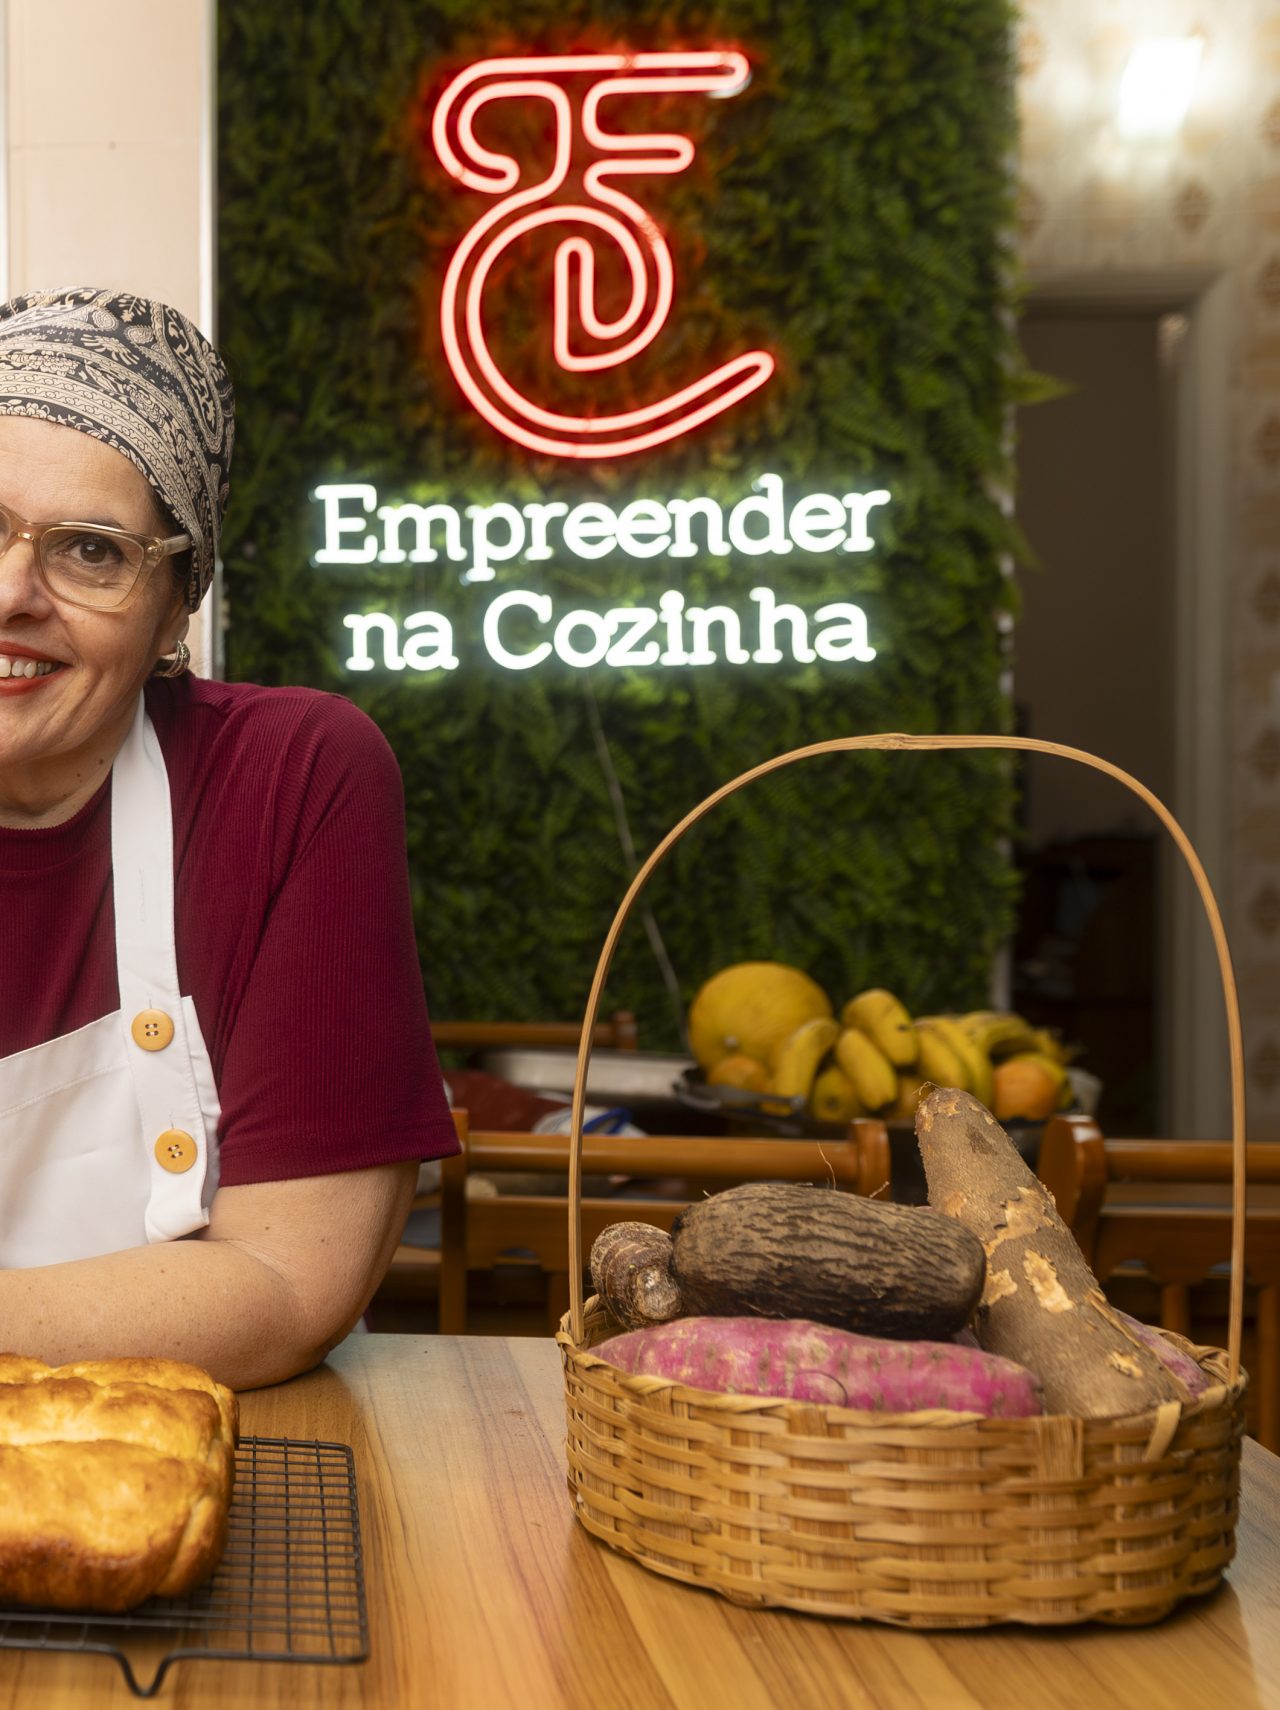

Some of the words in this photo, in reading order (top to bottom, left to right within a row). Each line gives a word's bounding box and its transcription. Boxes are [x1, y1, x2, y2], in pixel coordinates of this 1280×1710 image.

[314, 473, 891, 582] Empreender
[343, 612, 459, 671] na
[483, 586, 877, 670] Cozinha
